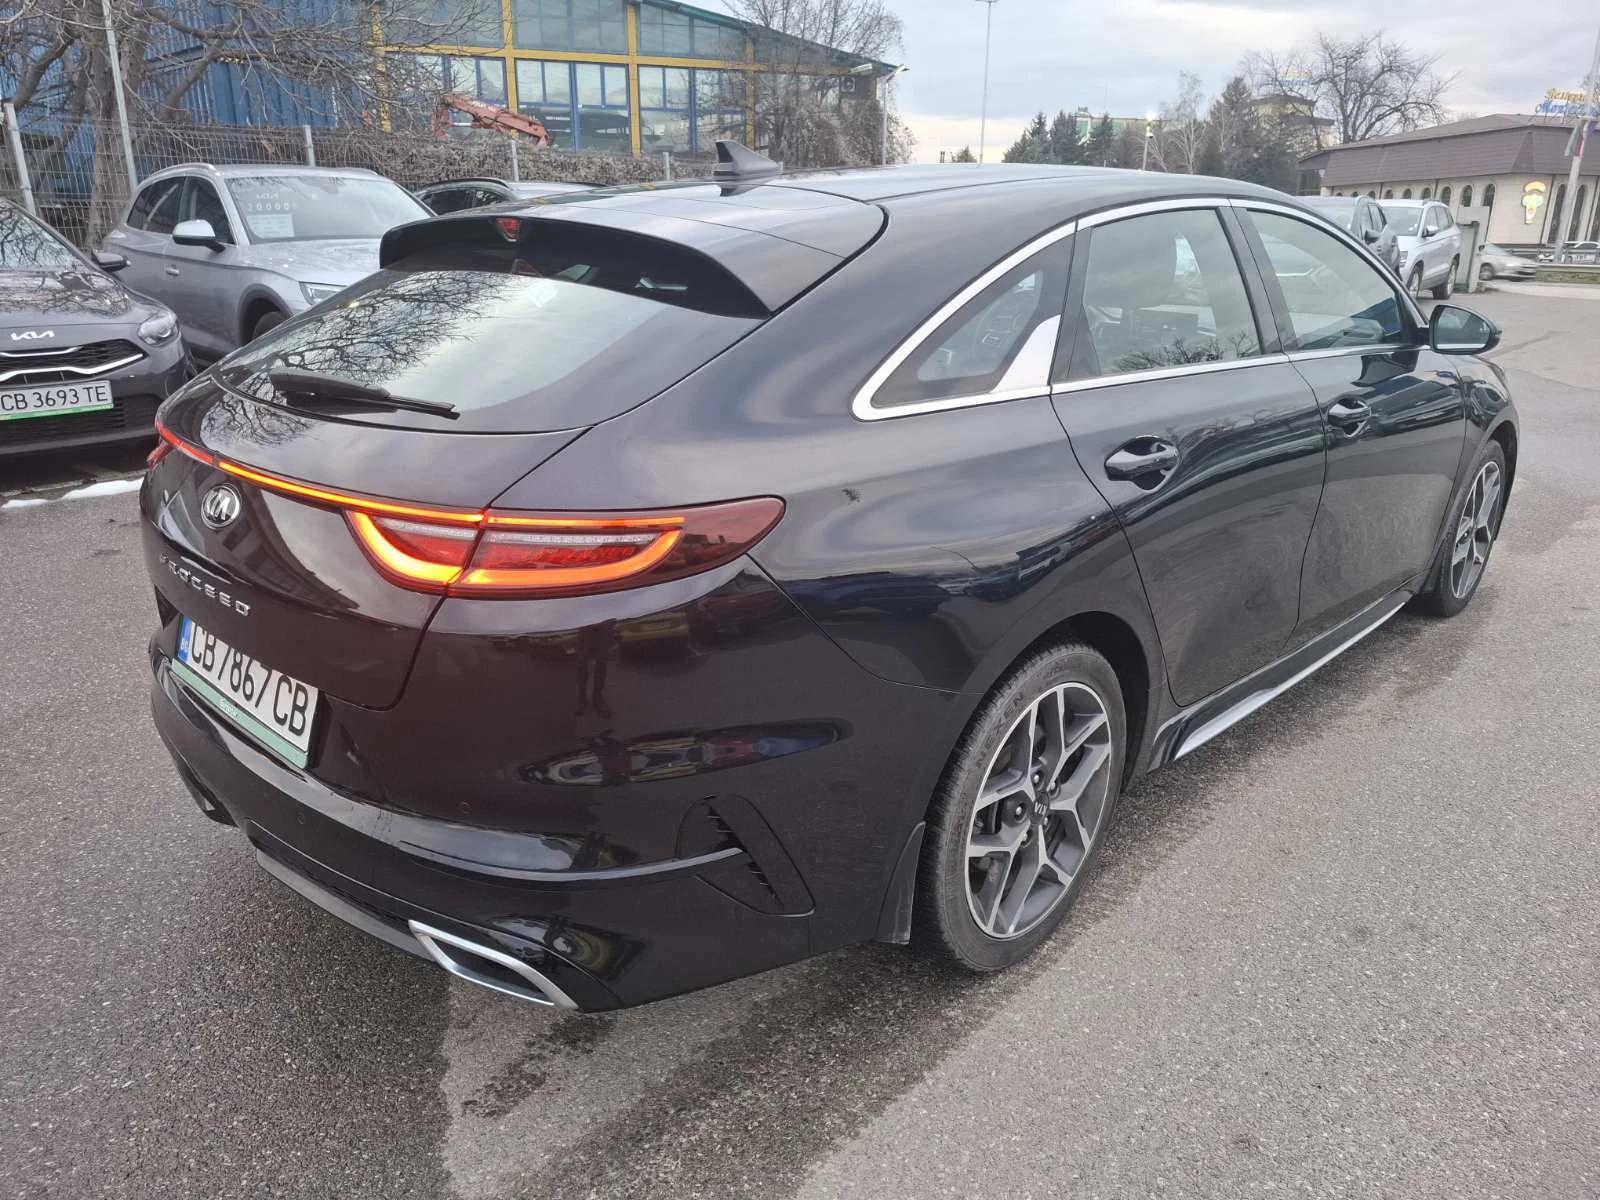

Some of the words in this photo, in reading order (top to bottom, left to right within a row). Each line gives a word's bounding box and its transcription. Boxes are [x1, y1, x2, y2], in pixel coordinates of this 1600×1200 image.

[0, 393, 28, 411] CB
[32, 388, 80, 408] 3693
[83, 385, 108, 403] TE
[191, 621, 216, 673] CB
[217, 644, 273, 708] 7867
[273, 674, 310, 737] CB
